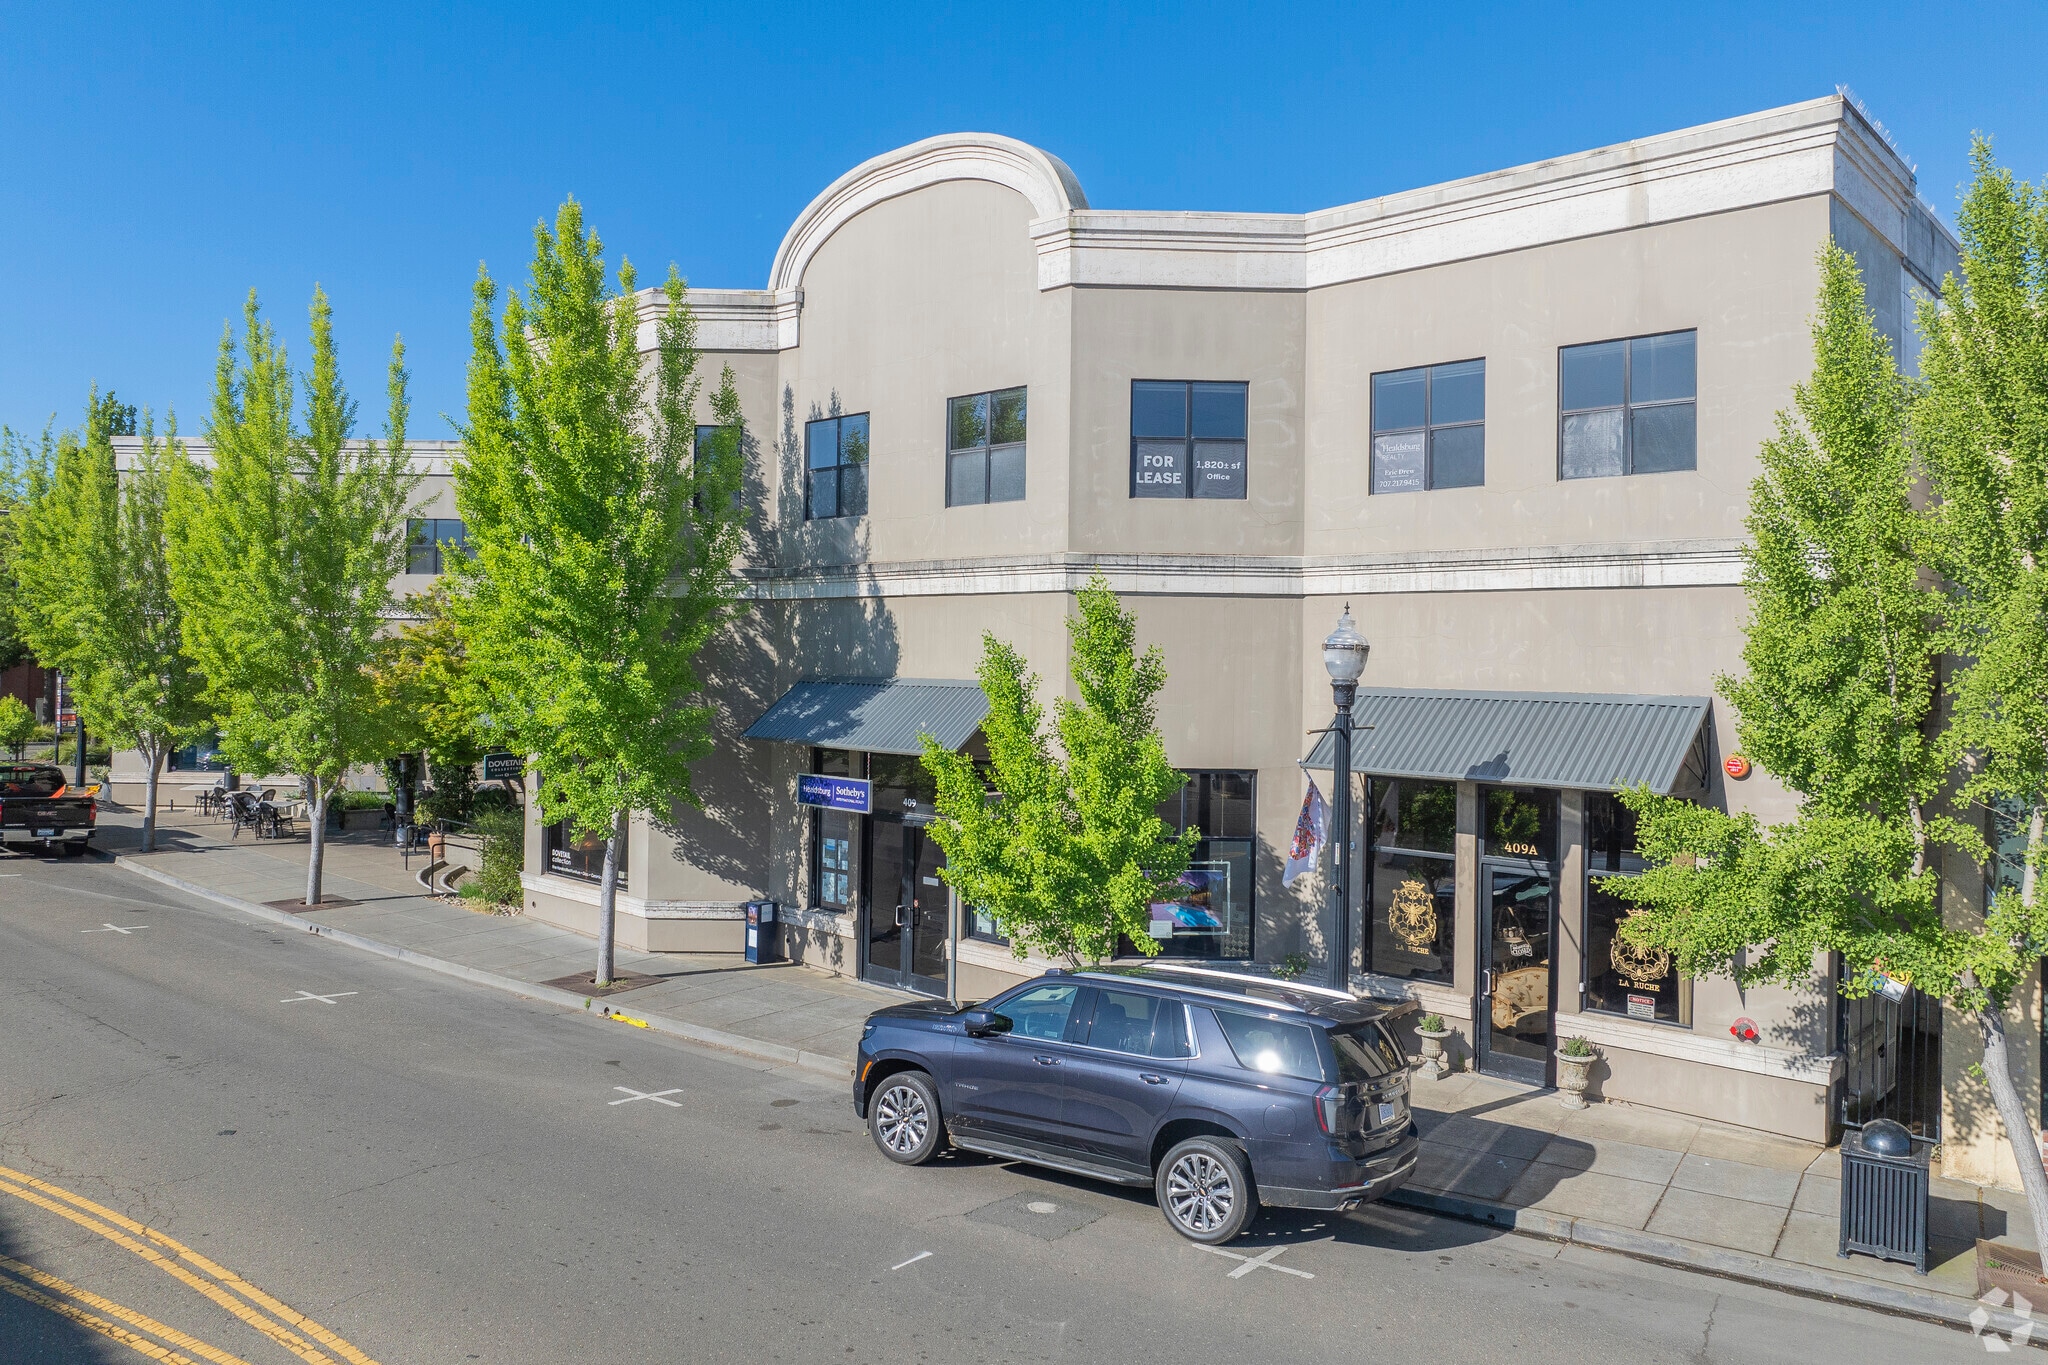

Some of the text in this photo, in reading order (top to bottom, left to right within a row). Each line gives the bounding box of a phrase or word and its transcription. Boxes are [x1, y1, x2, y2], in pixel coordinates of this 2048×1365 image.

[1143, 455, 1174, 468] FOR
[1230, 461, 1241, 470] sf
[1136, 472, 1182, 484] LEASE
[1206, 473, 1230, 481] Office
[803, 784, 865, 799] Healdsburg Sotheby's
[903, 798, 917, 808] 409
[1504, 842, 1539, 856] 409A
[1395, 943, 1430, 955] LA RUCHE
[1619, 979, 1660, 992] LA RUCHE
